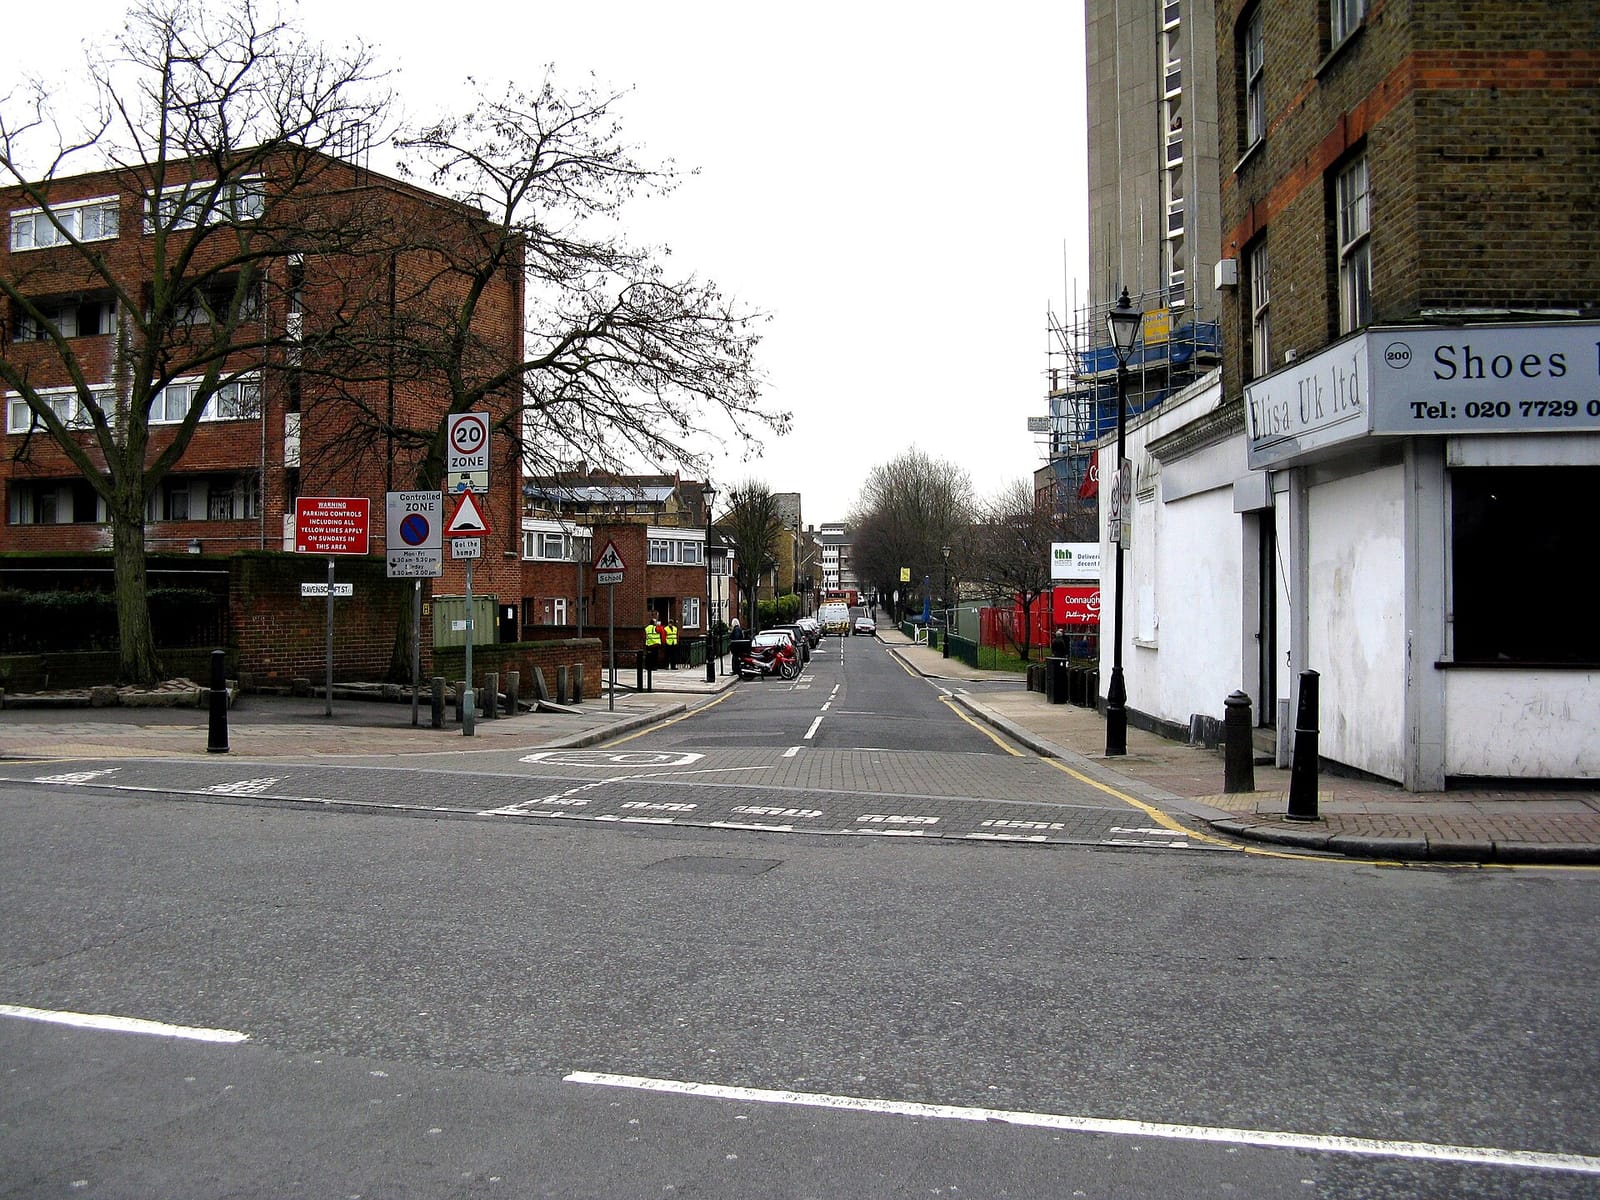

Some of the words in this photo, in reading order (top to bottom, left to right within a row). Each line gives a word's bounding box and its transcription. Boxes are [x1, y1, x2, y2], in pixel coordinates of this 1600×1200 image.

[1387, 351, 1409, 360] 200
[1433, 345, 1567, 380] Shoes
[1298, 374, 1324, 425] Uk
[1332, 355, 1360, 414] ltd
[1410, 401, 1456, 419] Tel:
[1464, 401, 1511, 418] 020
[1519, 400, 1578, 417] 7729
[456, 427, 481, 443] 20
[452, 457, 484, 467] ZONE
[400, 493, 441, 501] Controlled
[405, 503, 435, 512] ZONE
